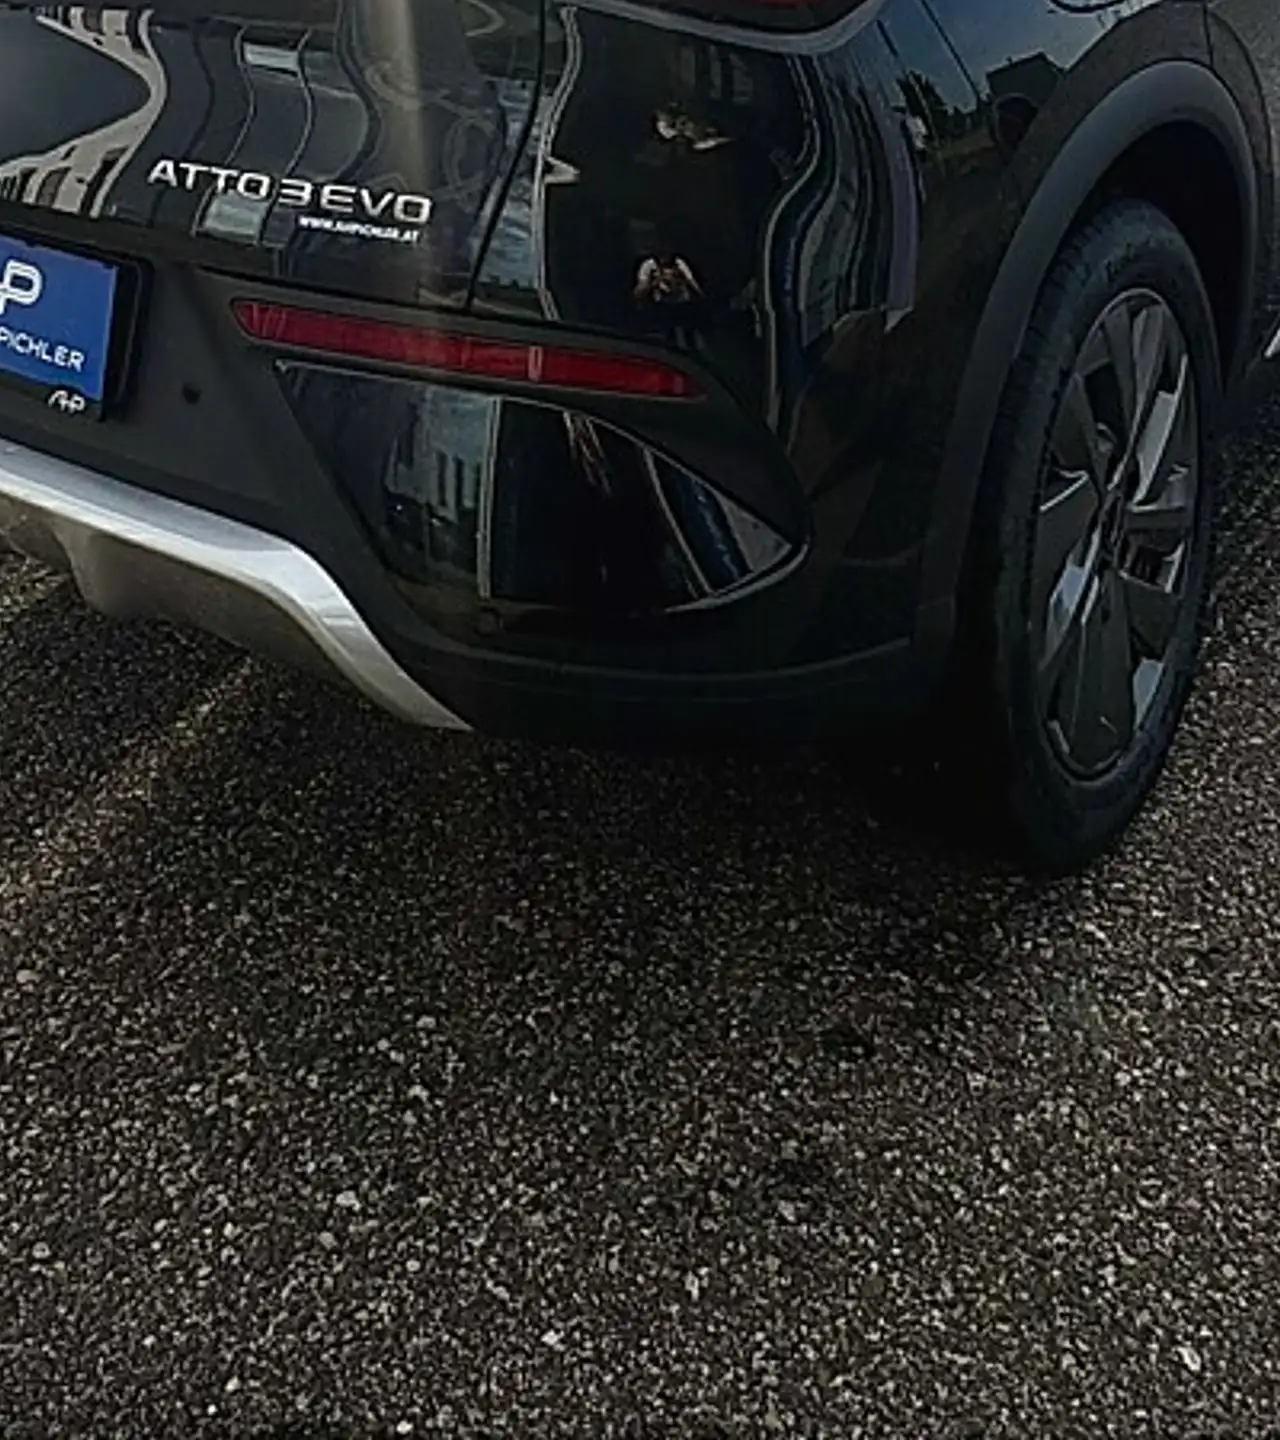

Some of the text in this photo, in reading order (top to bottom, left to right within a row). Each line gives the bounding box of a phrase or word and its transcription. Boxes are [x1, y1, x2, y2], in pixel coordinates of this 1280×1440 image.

[146, 158, 433, 225] ATTO 3 EVO
